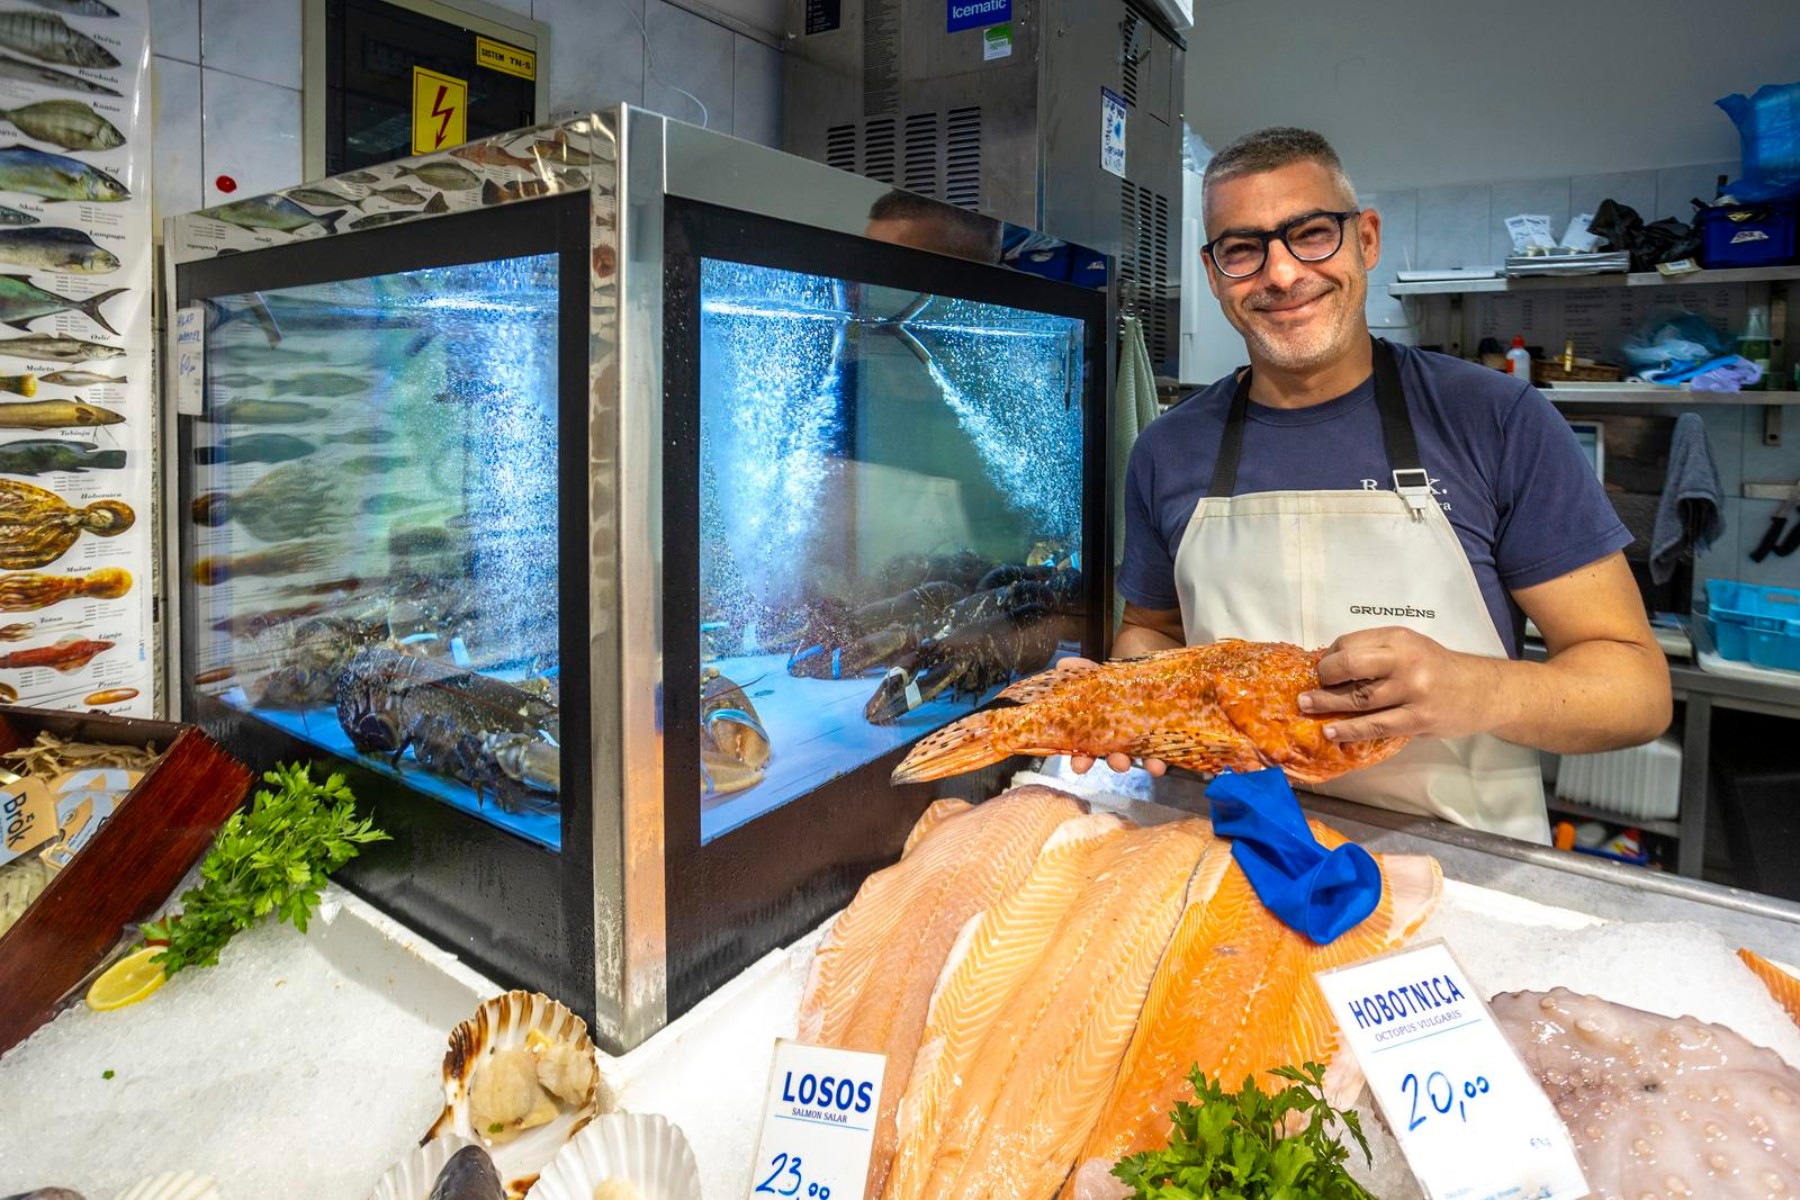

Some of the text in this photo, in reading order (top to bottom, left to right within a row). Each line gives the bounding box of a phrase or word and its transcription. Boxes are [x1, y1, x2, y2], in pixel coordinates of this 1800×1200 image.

[953, 0, 1007, 19] Icematic
[509, 56, 531, 70] TN-S
[1348, 975, 1465, 1029] HOBOTNICA
[1375, 1009, 1463, 1042] OCTOPUS VULGARIS
[782, 1071, 874, 1113] LOSOS
[1401, 1071, 1490, 1131] 20,00
[792, 1107, 848, 1123] SALMON SALAR
[755, 1152, 831, 1200] 2300
